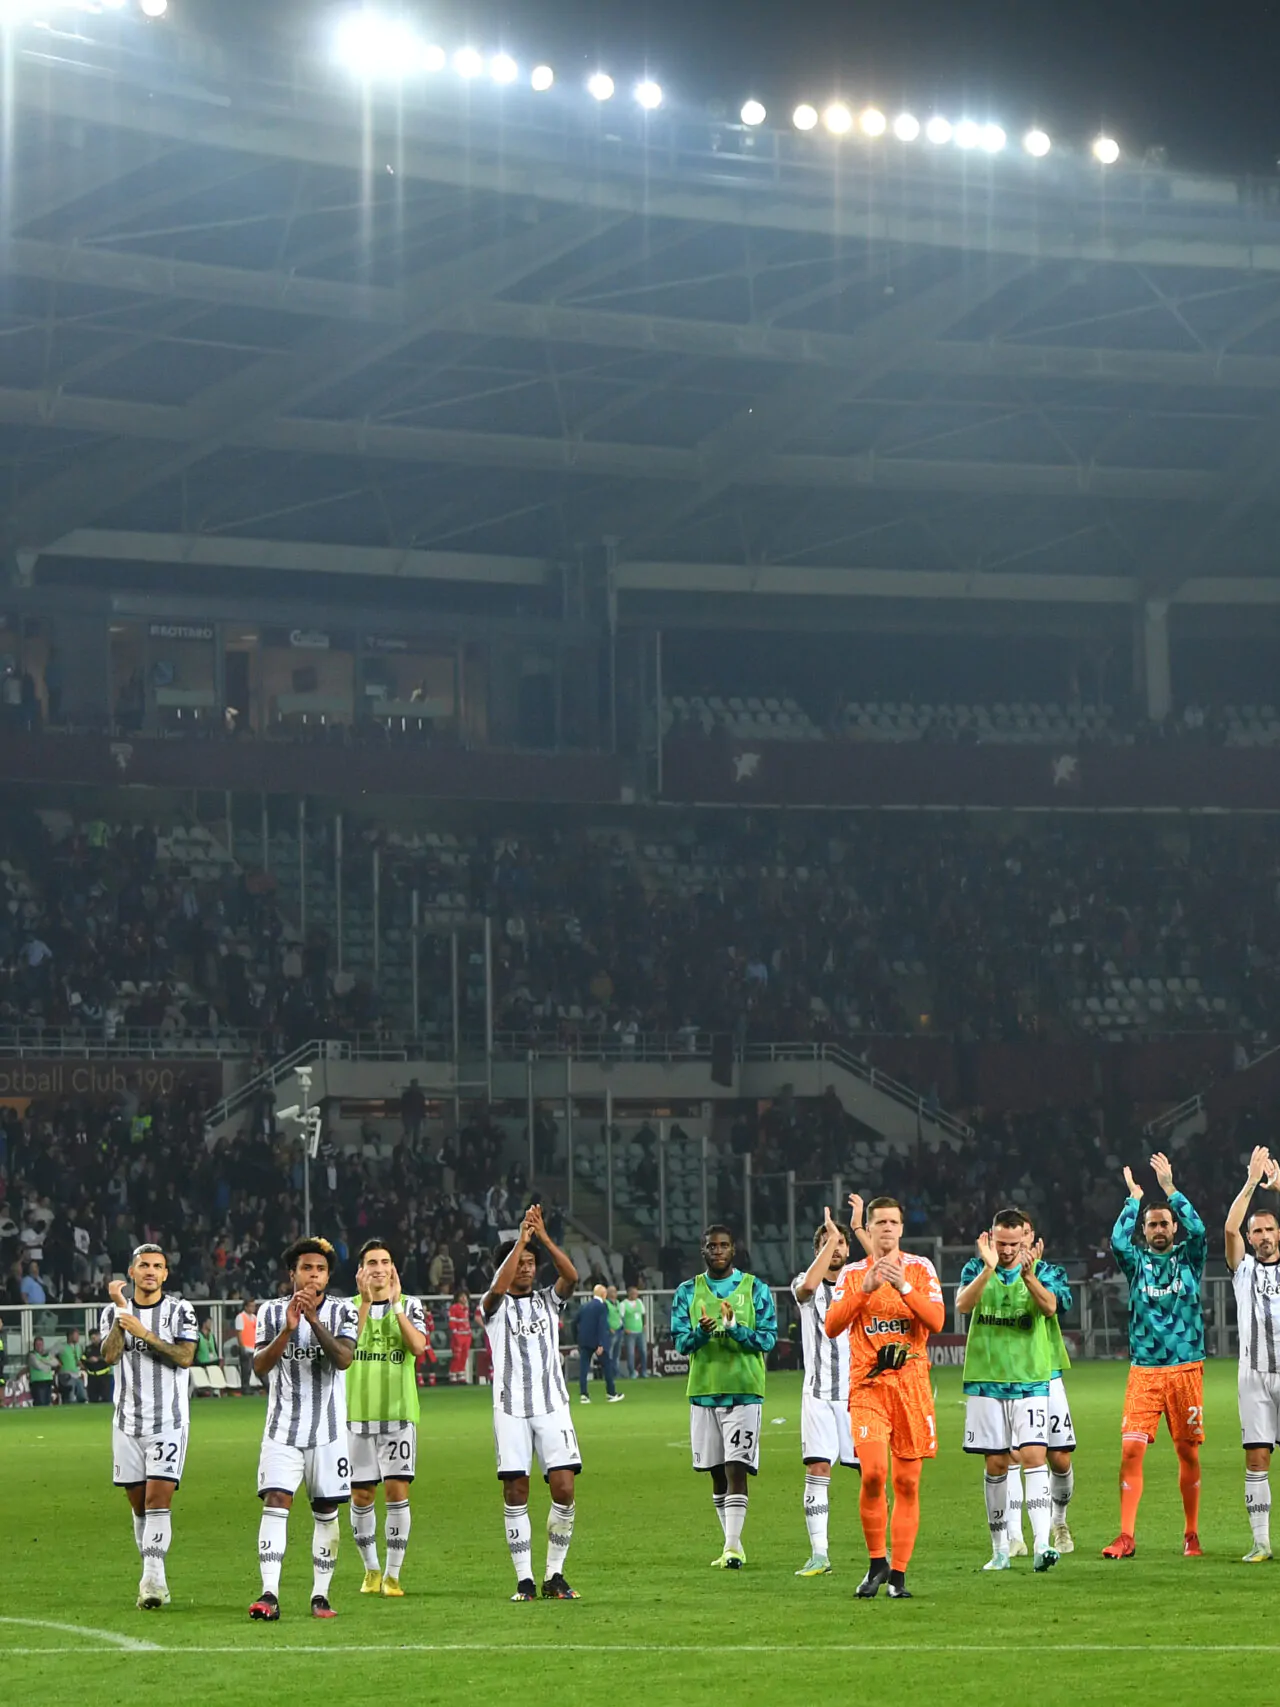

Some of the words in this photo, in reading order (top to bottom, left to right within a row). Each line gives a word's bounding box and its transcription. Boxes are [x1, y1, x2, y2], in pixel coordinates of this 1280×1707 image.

[72, 1066, 126, 1092] Club
[512, 1318, 548, 1337] Jeep
[865, 1316, 911, 1335] Jeep
[977, 1314, 1016, 1327] Allianz
[1027, 1409, 1045, 1428] 15
[1050, 1412, 1072, 1434] 24
[561, 1429, 577, 1449] 11
[730, 1429, 754, 1450] 43
[153, 1442, 178, 1462] 32
[388, 1440, 411, 1460] 20
[337, 1457, 349, 1478] 8
